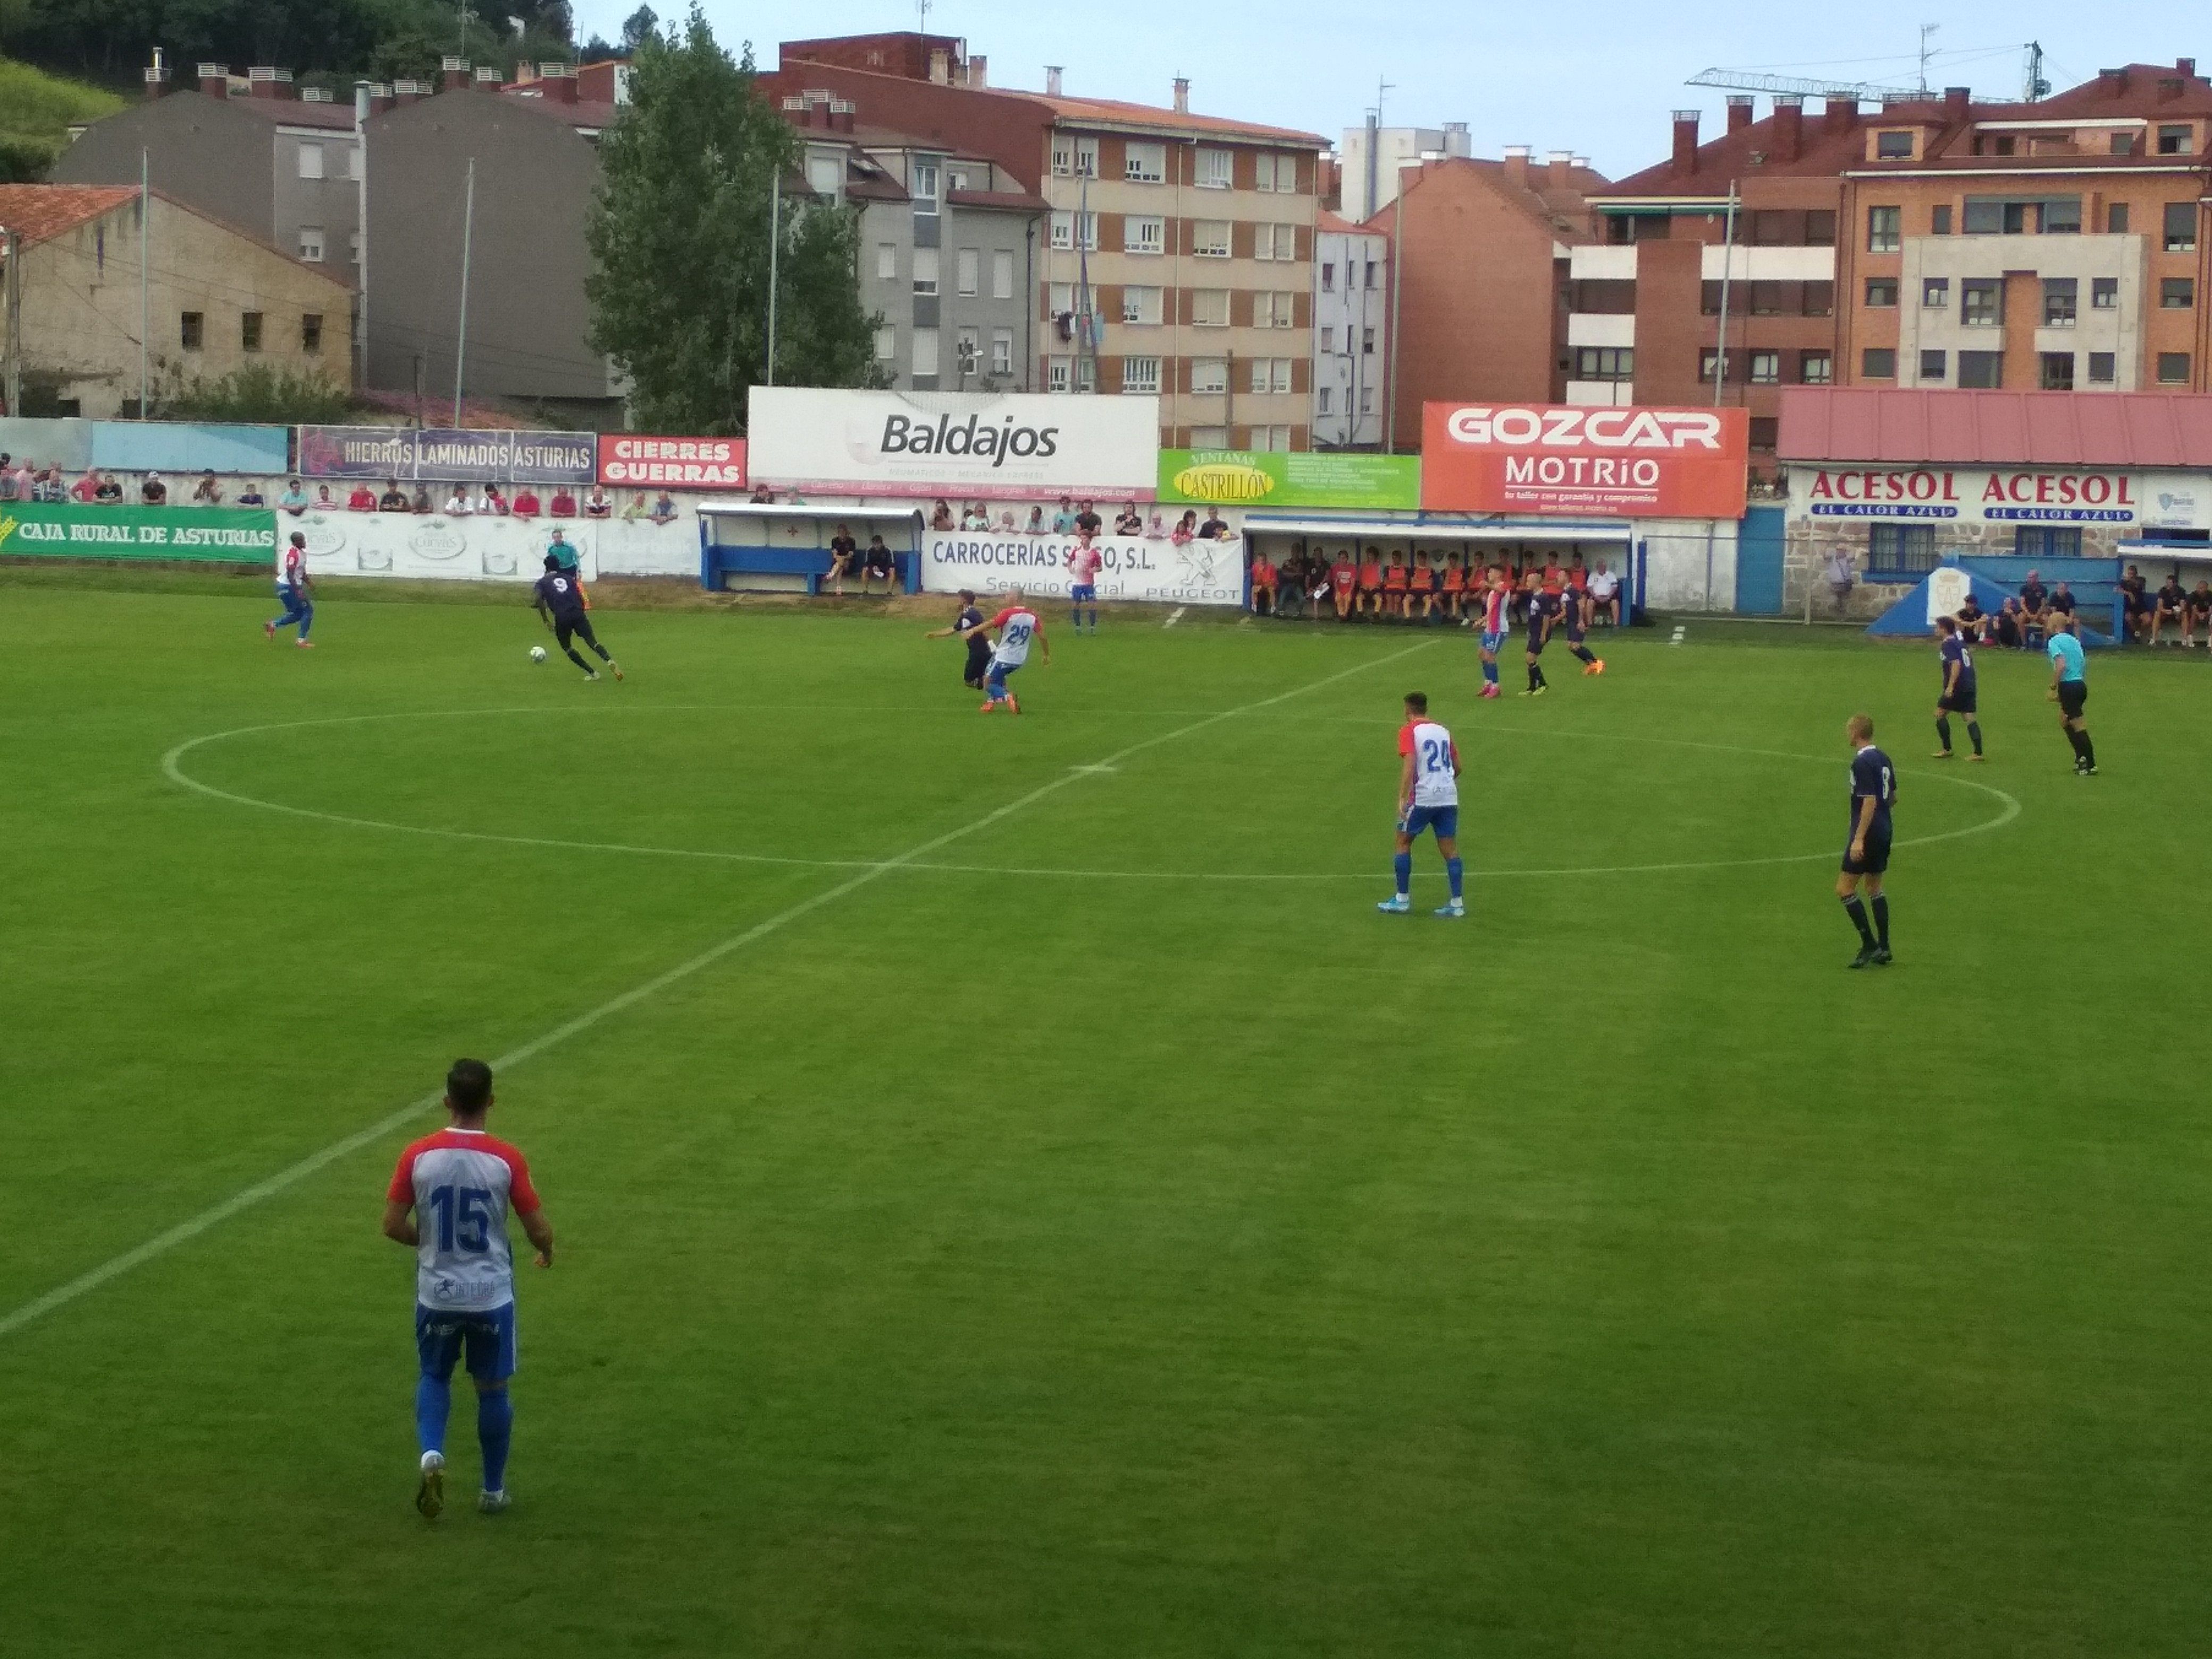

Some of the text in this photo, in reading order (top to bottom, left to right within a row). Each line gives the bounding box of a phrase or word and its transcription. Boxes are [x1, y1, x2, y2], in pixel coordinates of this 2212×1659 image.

[881, 413, 1059, 467] Baldajos
[1447, 408, 1722, 449] GOZCAR
[345, 441, 591, 469] HIERROS LAMINADOS ASTURIAS
[615, 440, 731, 461] CIERRES
[605, 462, 740, 483] GUERRAS
[1809, 470, 1960, 500] ACESOL
[1982, 473, 2134, 505] ACESOL
[1844, 505, 1899, 515] CALOR
[2016, 509, 2073, 519] CALOR
[20, 523, 274, 547] CAJA RURAL DE ASTURIAS
[933, 539, 1057, 567] CARROCERÍAS
[1126, 546, 1155, 570] S.L.
[554, 577, 568, 592] 9
[1145, 586, 1239, 600] PEUGEOT
[1007, 624, 1031, 646] 29
[430, 1185, 492, 1254] 15
